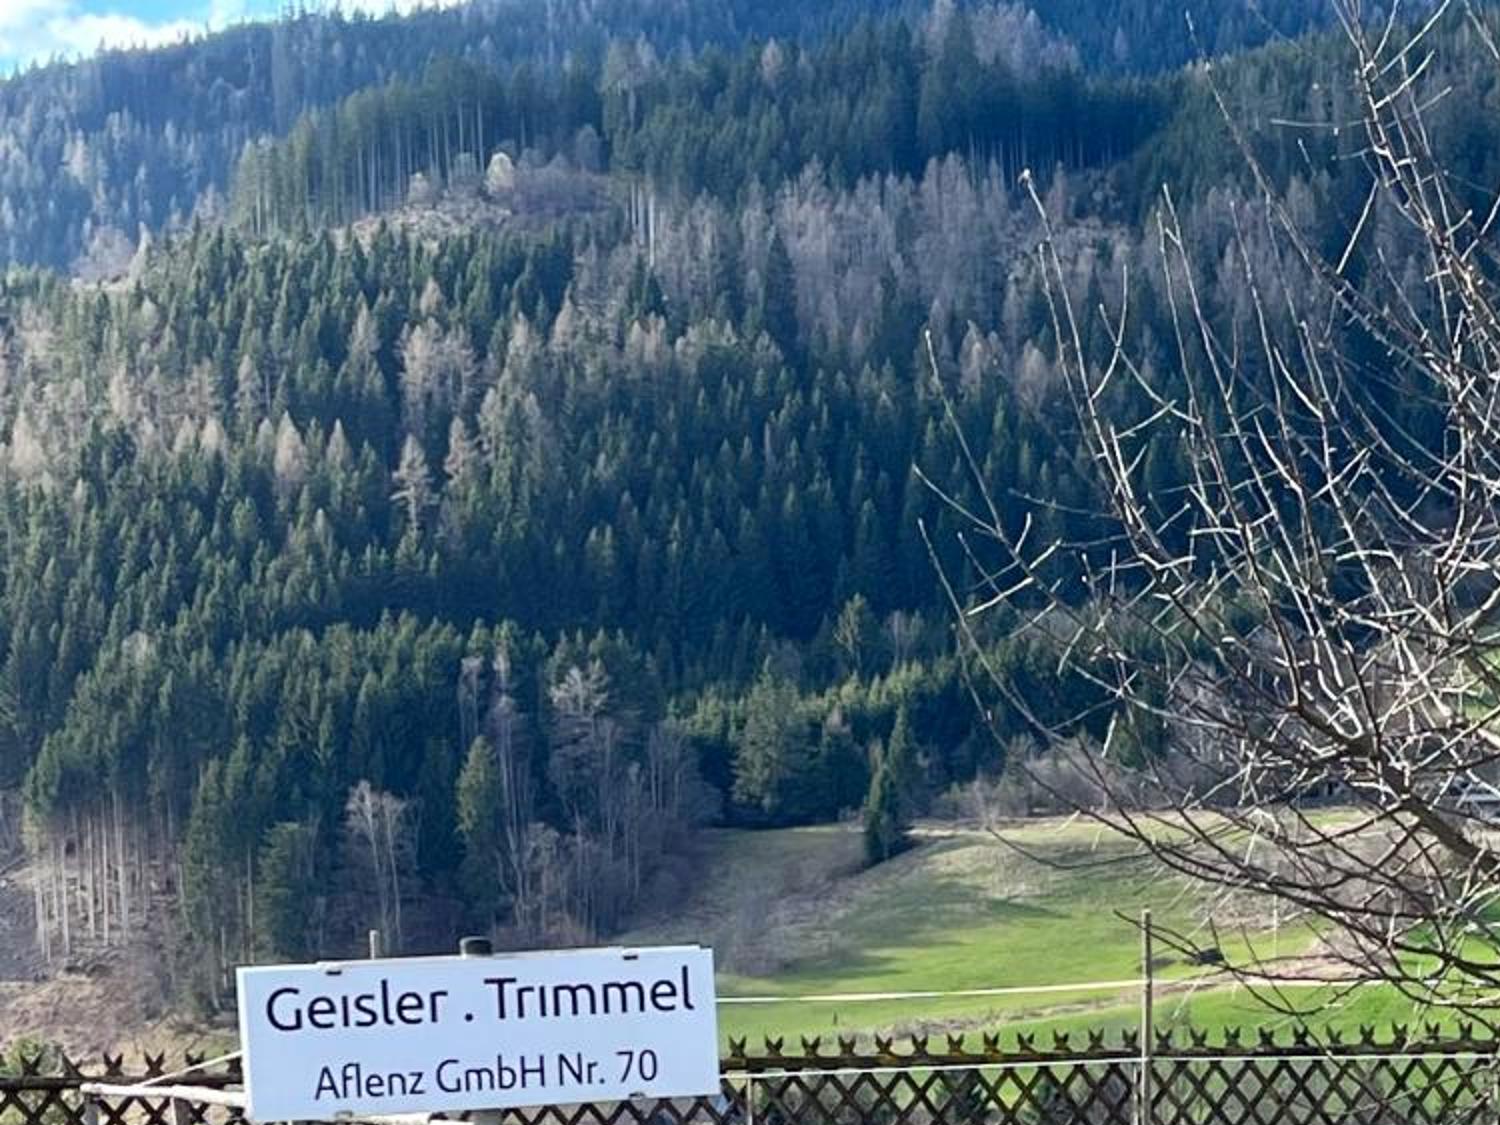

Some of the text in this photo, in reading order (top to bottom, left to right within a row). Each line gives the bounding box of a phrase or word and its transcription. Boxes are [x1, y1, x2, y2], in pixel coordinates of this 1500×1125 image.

[266, 979, 449, 1031] Geisler
[484, 965, 695, 1020] Trimmel
[315, 1049, 658, 1100] Aflenz GmbH Nr. 70
